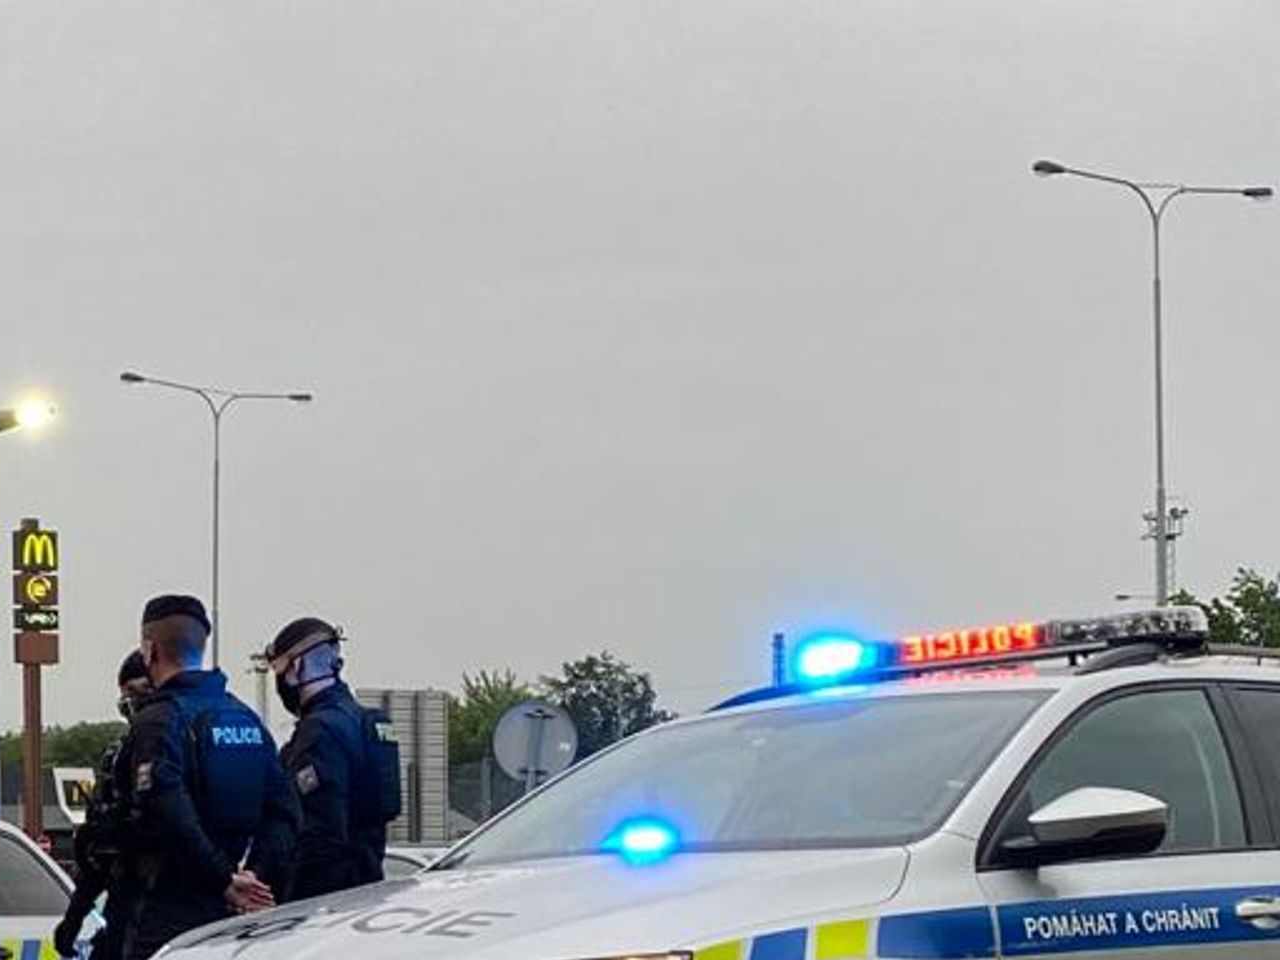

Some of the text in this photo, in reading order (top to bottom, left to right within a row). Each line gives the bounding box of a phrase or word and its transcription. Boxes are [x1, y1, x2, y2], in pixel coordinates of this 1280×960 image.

[212, 726, 263, 746] POLICIE
[1024, 903, 1220, 939] POMÁHAT A CHRÁNIT
